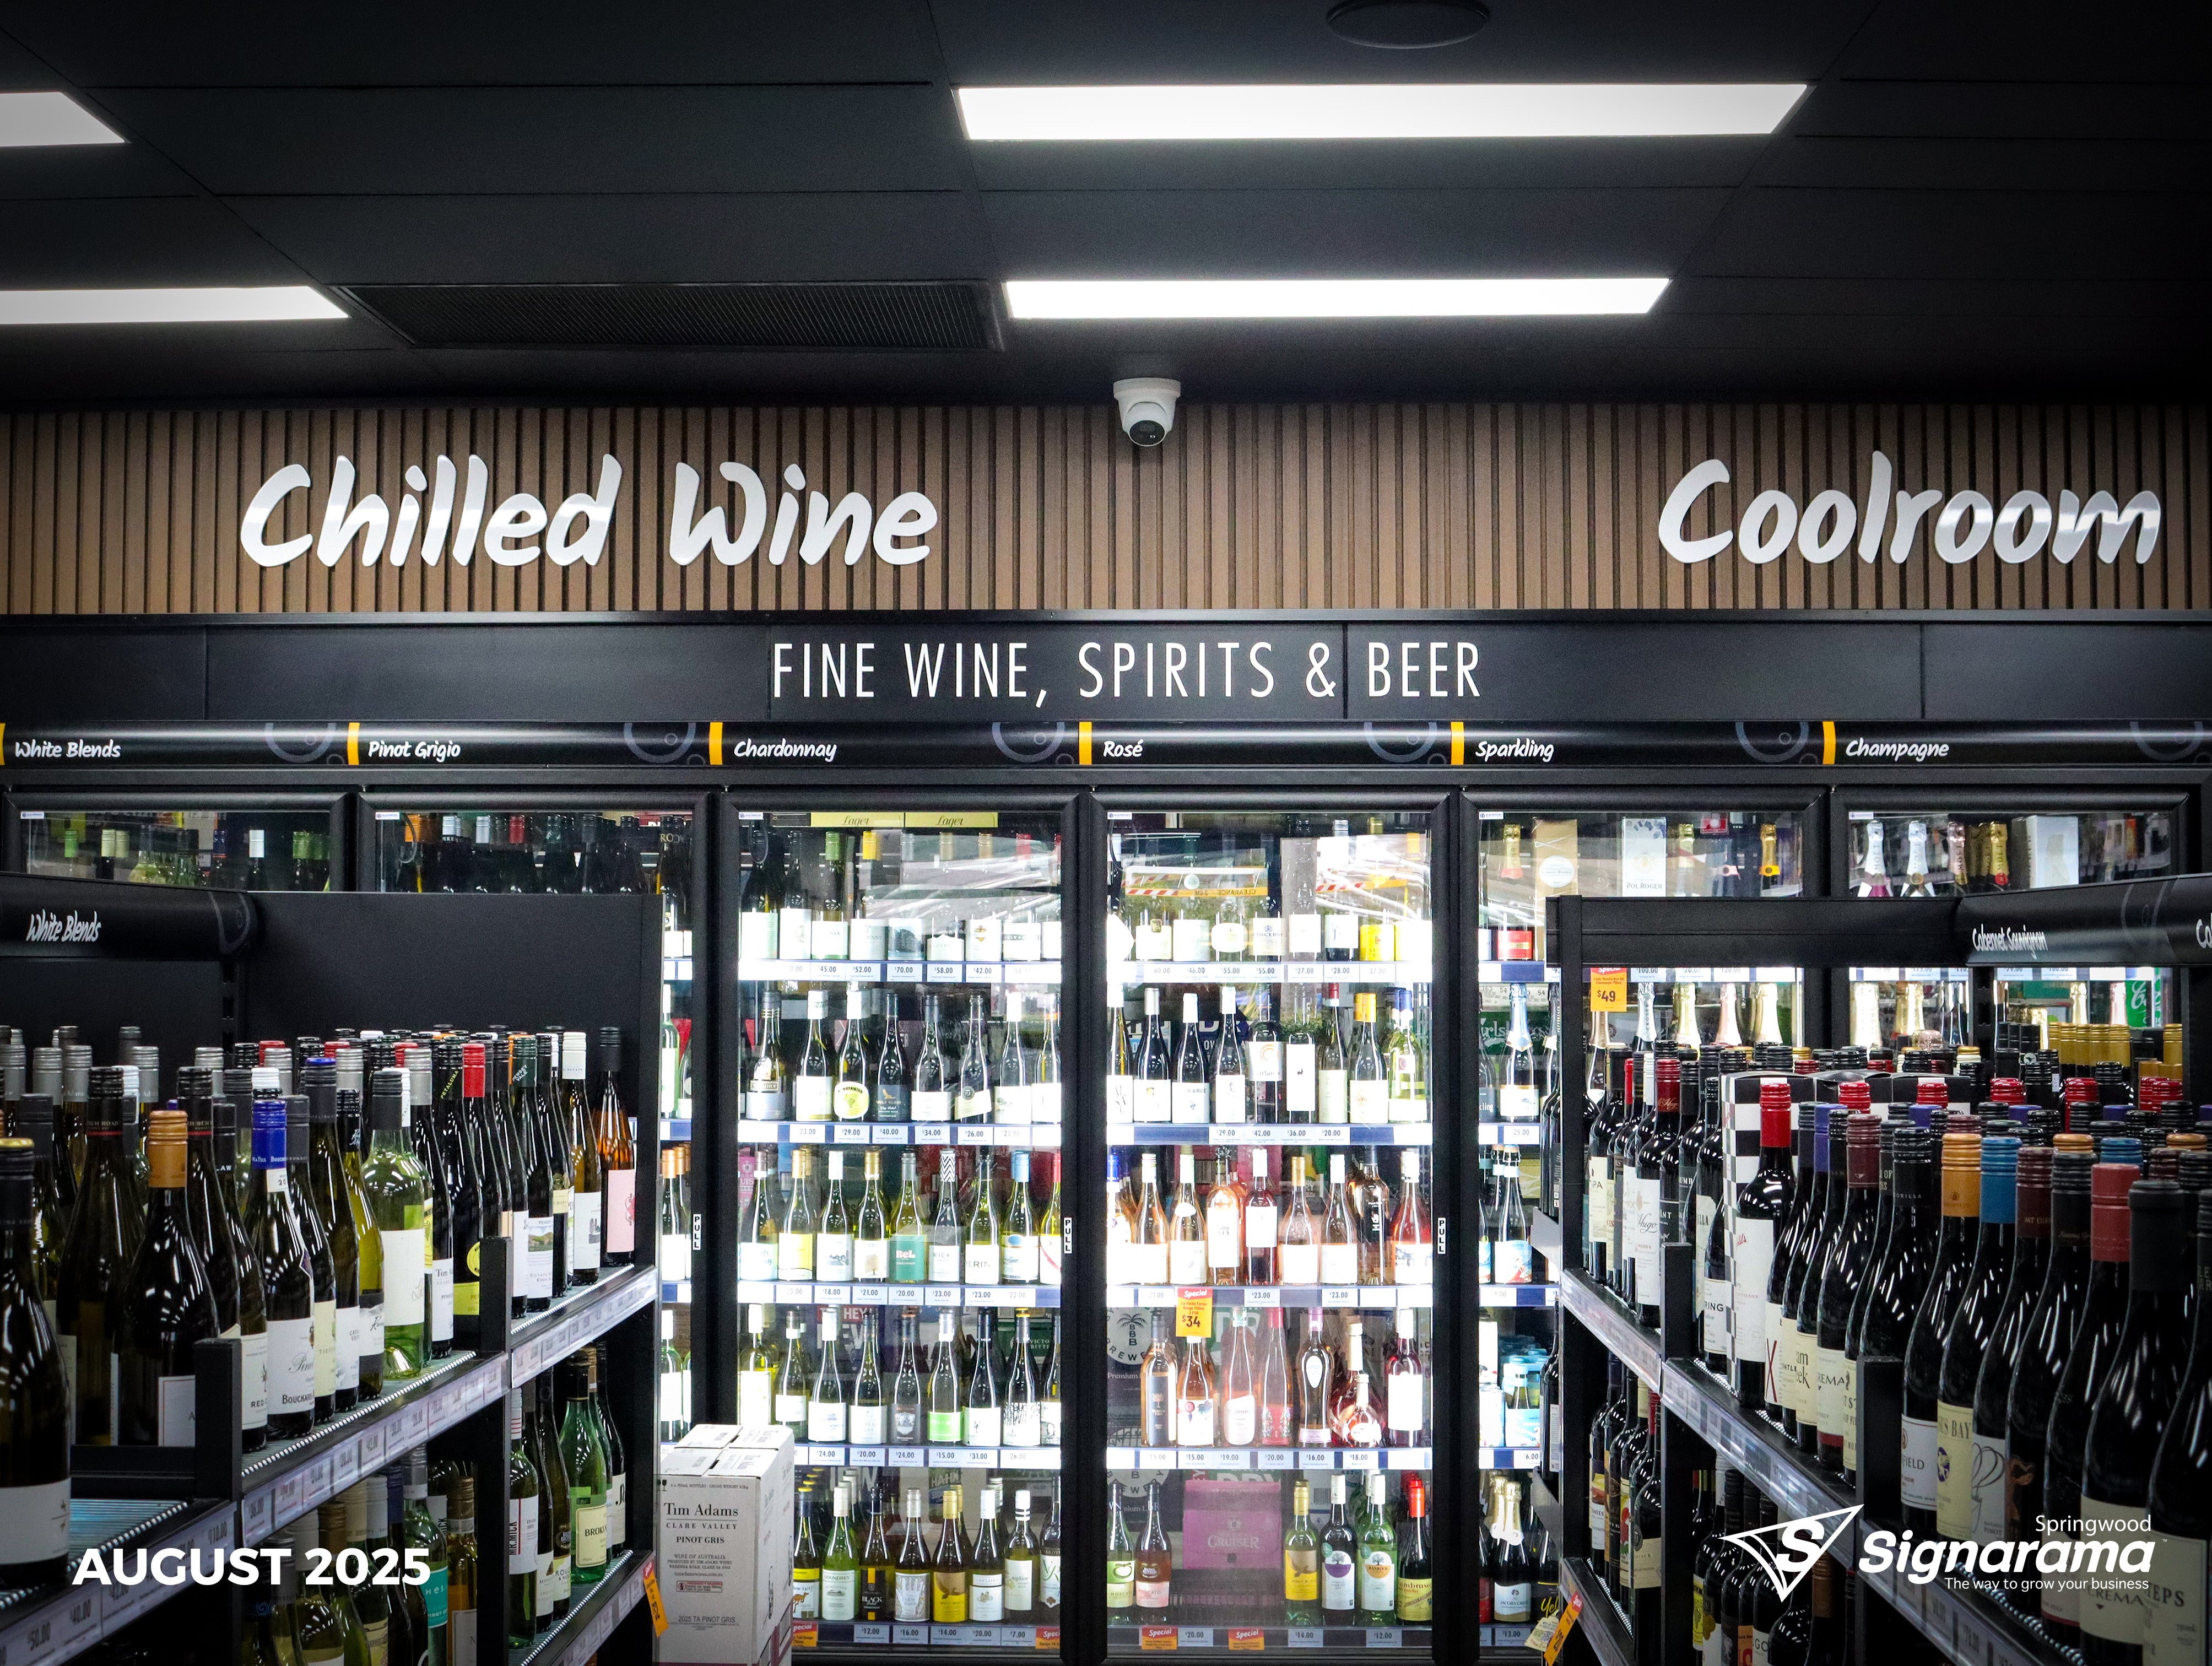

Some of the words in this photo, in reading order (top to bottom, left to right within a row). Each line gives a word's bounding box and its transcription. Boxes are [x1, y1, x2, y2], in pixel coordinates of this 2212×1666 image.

[241, 454, 622, 567] Chilled
[669, 462, 938, 566] Wine
[1658, 451, 2161, 564] Coolroom
[775, 643, 875, 698] FINE
[904, 642, 1047, 708] WINE,
[1079, 641, 1274, 698] SPIRITS
[1306, 641, 1337, 697] &
[1369, 642, 1480, 697] BEER
[15, 739, 62, 758] White
[66, 739, 121, 758] Blends
[368, 739, 410, 758] Pinot
[414, 739, 461, 762] Grigio
[734, 738, 837, 762] Chardonnay
[1104, 739, 1143, 758] Rosé
[1475, 738, 1554, 762] Sparkling
[1846, 737, 1949, 762] Champagne
[26, 909, 61, 942] White
[61, 910, 102, 942] Blends
[1972, 923, 2008, 951] Cabernet
[2008, 924, 2048, 959] Sauvignon
[1597, 989, 1616, 1003] $49
[440, 1070, 459, 1100] PETALUMA
[516, 1070, 528, 1082] VALE
[1183, 1289, 1208, 1299] Special
[1704, 1302, 1724, 1312] RING
[1182, 1315, 1201, 1328] $34
[1951, 1420, 1971, 1440] BAY
[931, 1470, 959, 1488] HAHN
[663, 1503, 690, 1516] Tim
[694, 1504, 739, 1517] Adams
[509, 1521, 517, 1555] MR.MICK
[1984, 1527, 2003, 1536] PINOT
[1208, 1535, 1259, 1549] CRUISER
[2087, 1585, 2144, 1606] CREMA
[2146, 1582, 2185, 1608] TEPS
[793, 1624, 813, 1633] pecial
[1149, 1629, 1172, 1638] Special
[1236, 1630, 1259, 1640] Special
